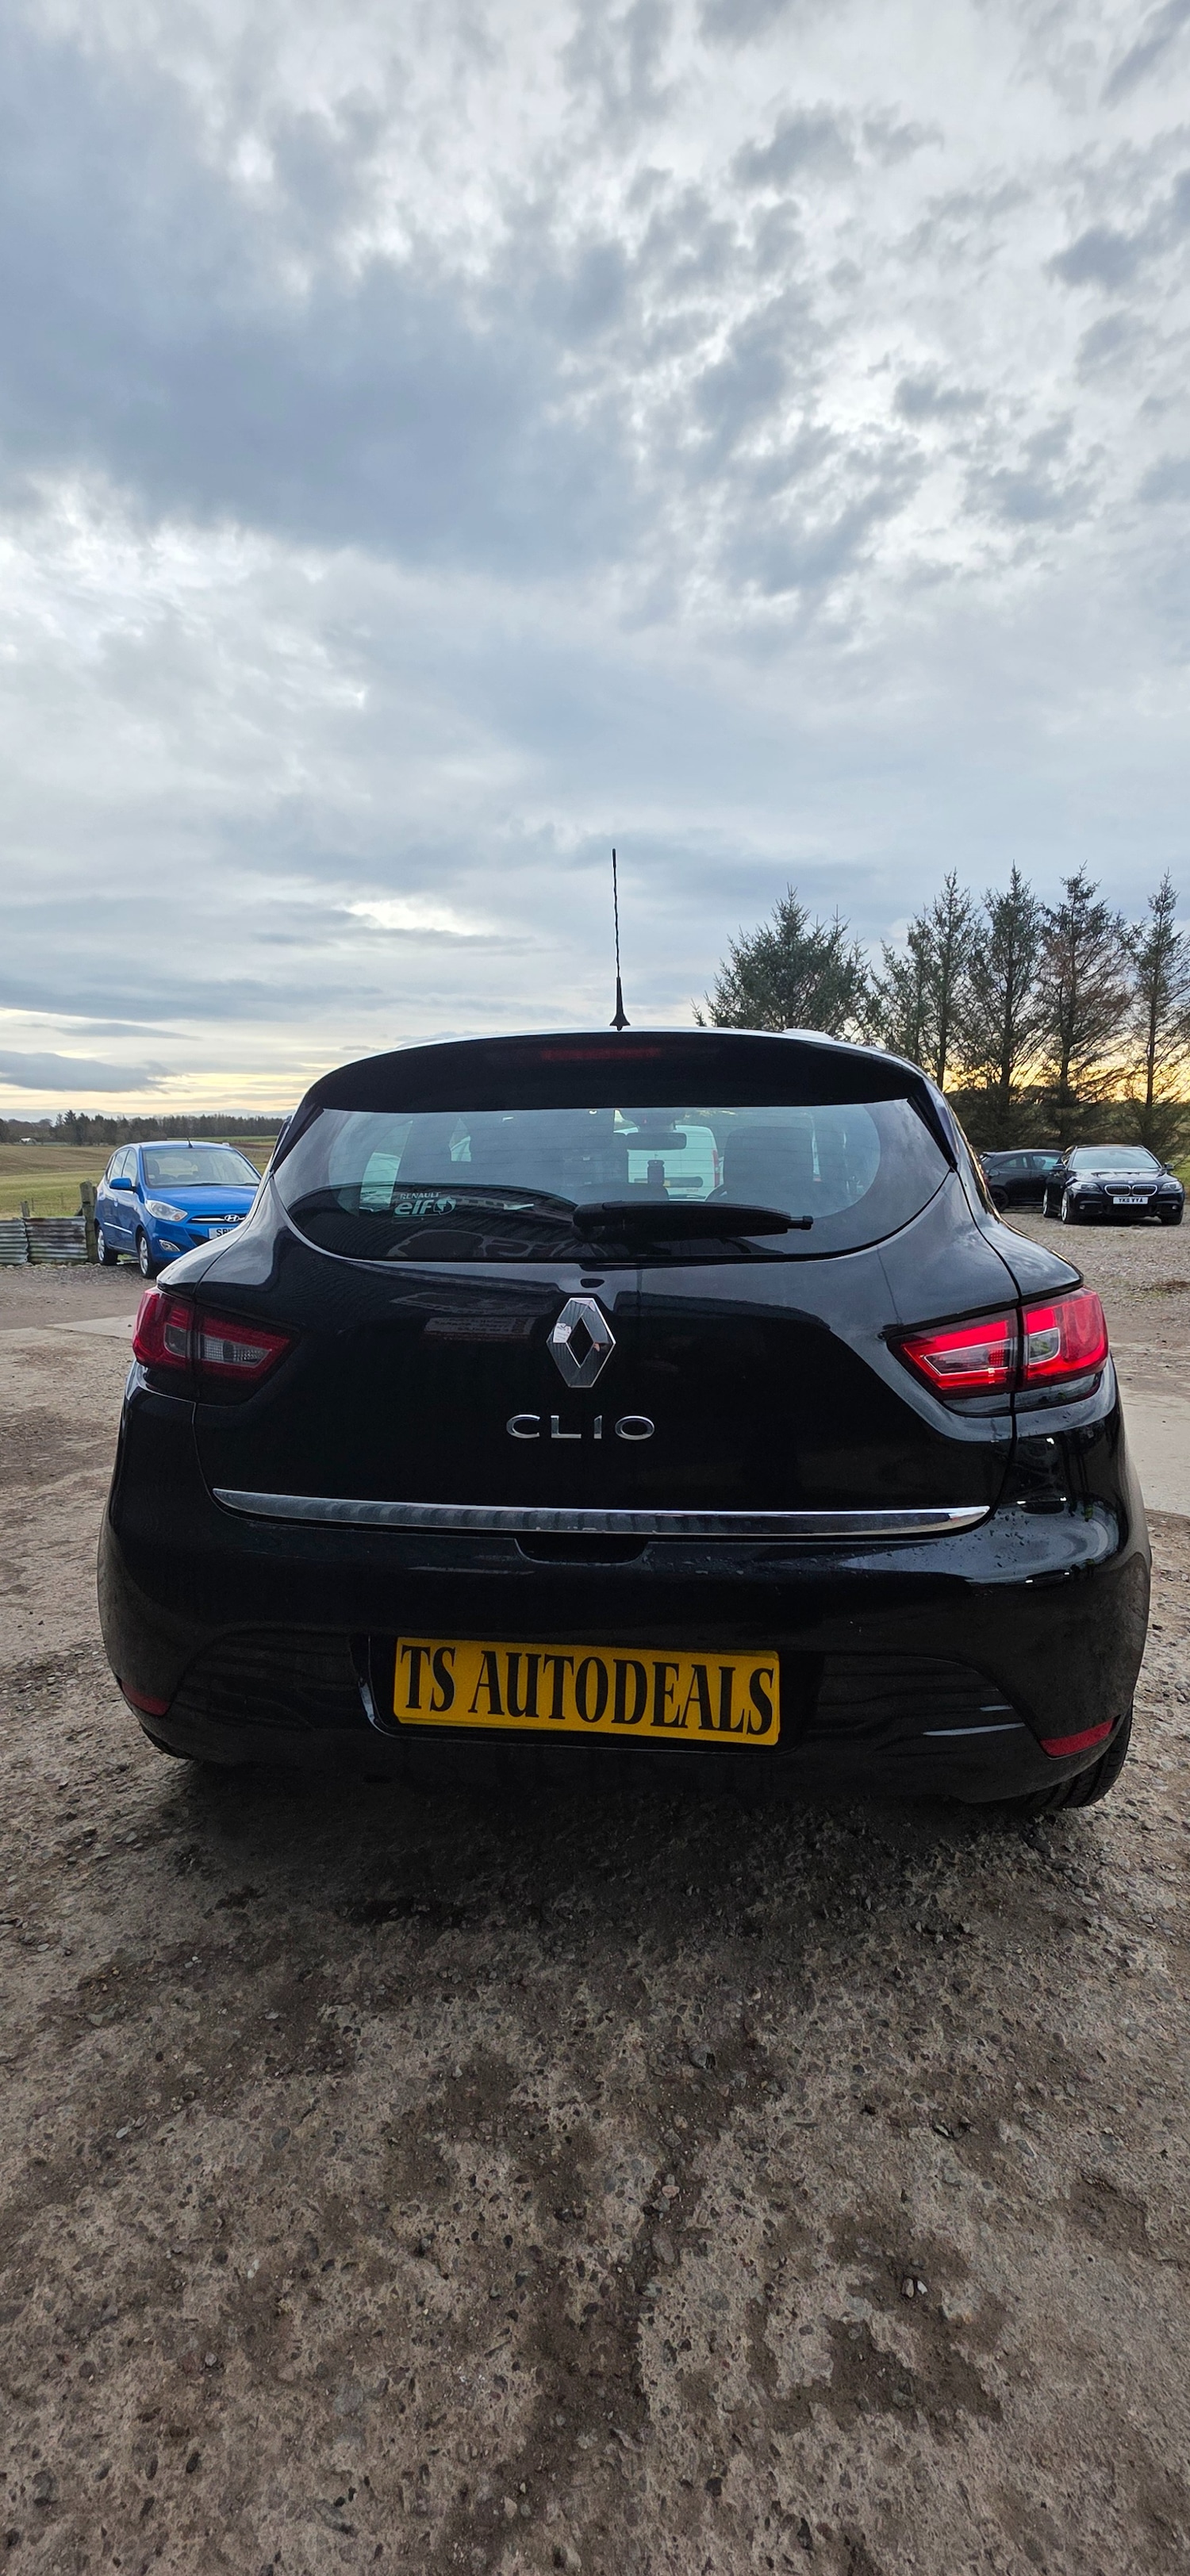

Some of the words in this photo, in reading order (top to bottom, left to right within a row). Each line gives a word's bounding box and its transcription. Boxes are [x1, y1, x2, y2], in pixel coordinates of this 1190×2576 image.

[394, 1200, 434, 1215] elf
[505, 1414, 655, 1441] CLIO
[400, 1645, 456, 1712] TS
[468, 1649, 774, 1736] AUTODEALS
